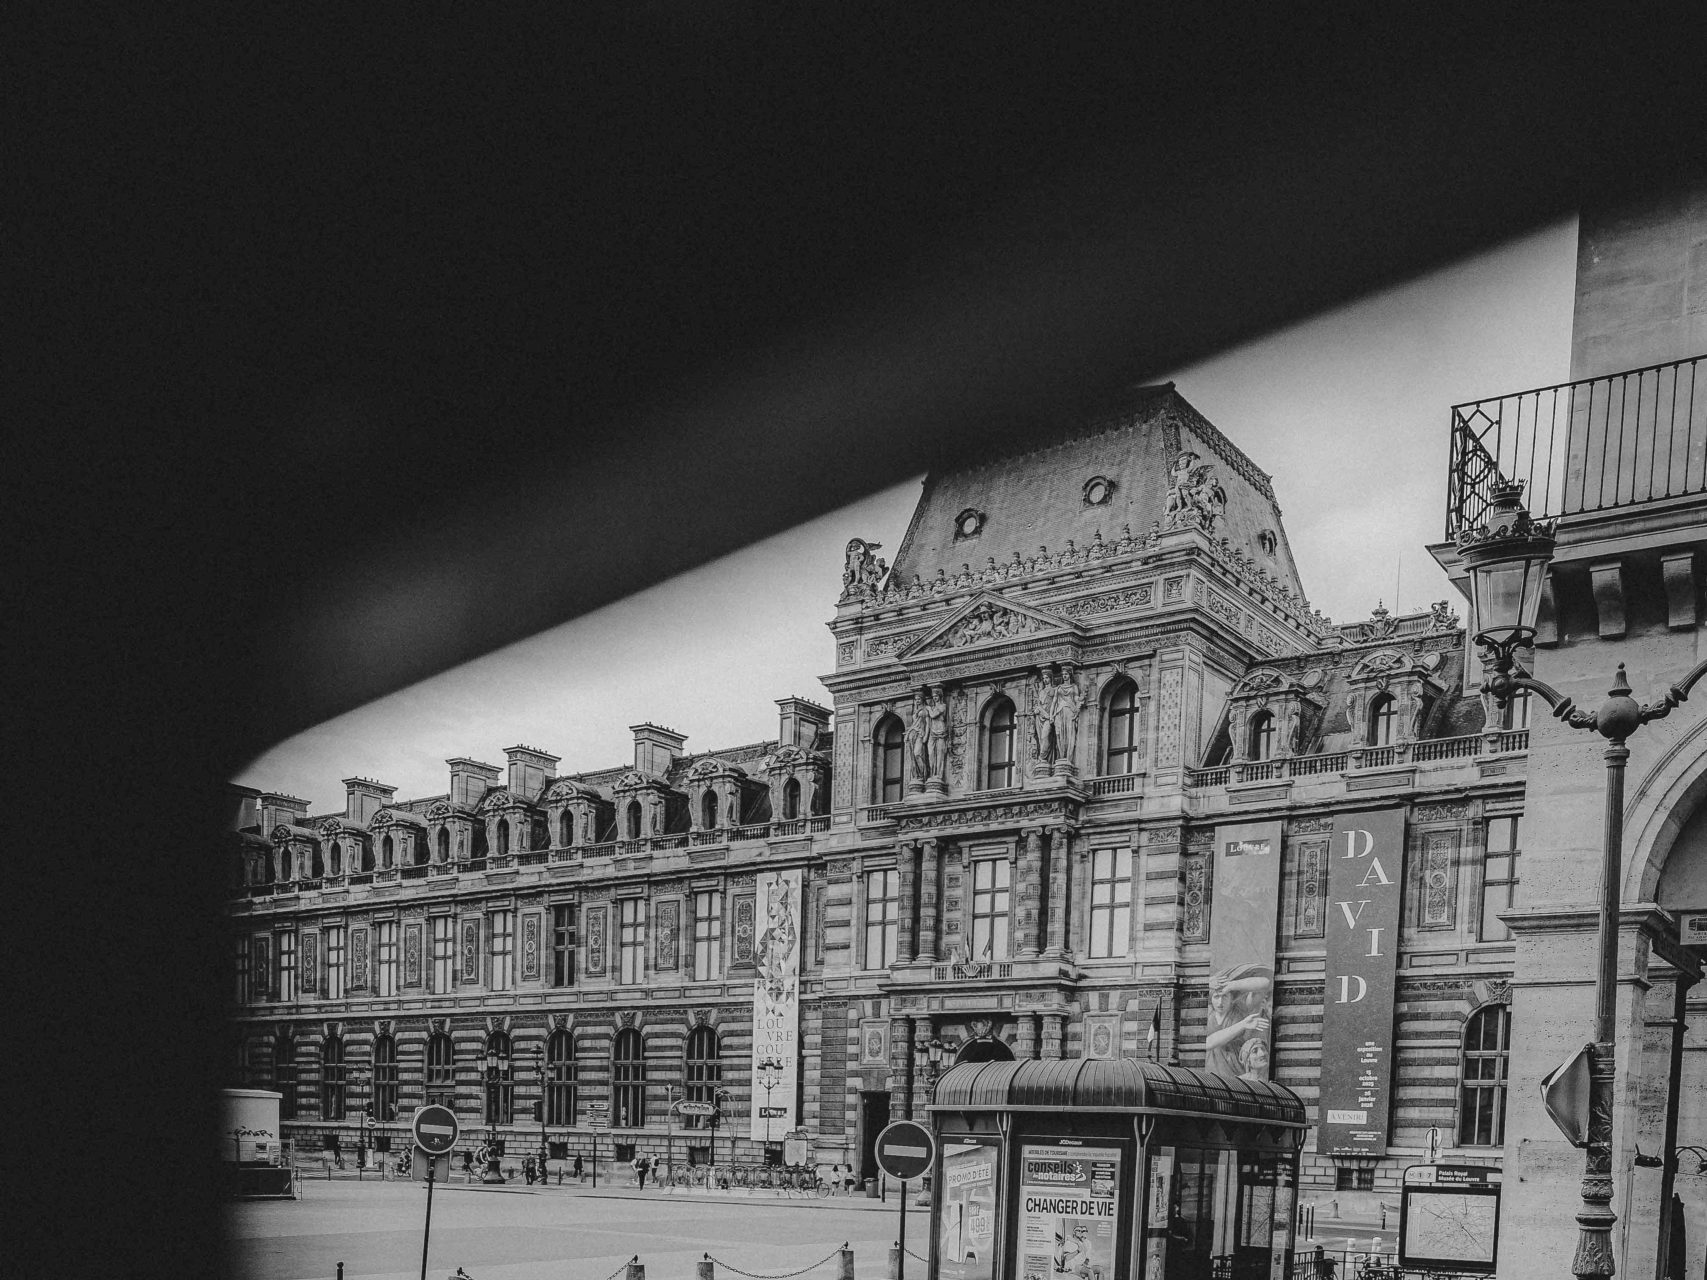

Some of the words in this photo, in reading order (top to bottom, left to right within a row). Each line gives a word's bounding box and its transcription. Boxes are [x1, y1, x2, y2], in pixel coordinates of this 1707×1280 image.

[757, 1018, 784, 1030] LOU
[766, 1030, 793, 1042] VRE
[756, 1043, 784, 1055] COU
[1028, 1161, 1074, 1174] conseils
[1038, 1172, 1076, 1181] notaires
[1026, 1197, 1079, 1215] CHANGER
[1080, 1200, 1095, 1216] DE
[1096, 1200, 1115, 1217] VIE
